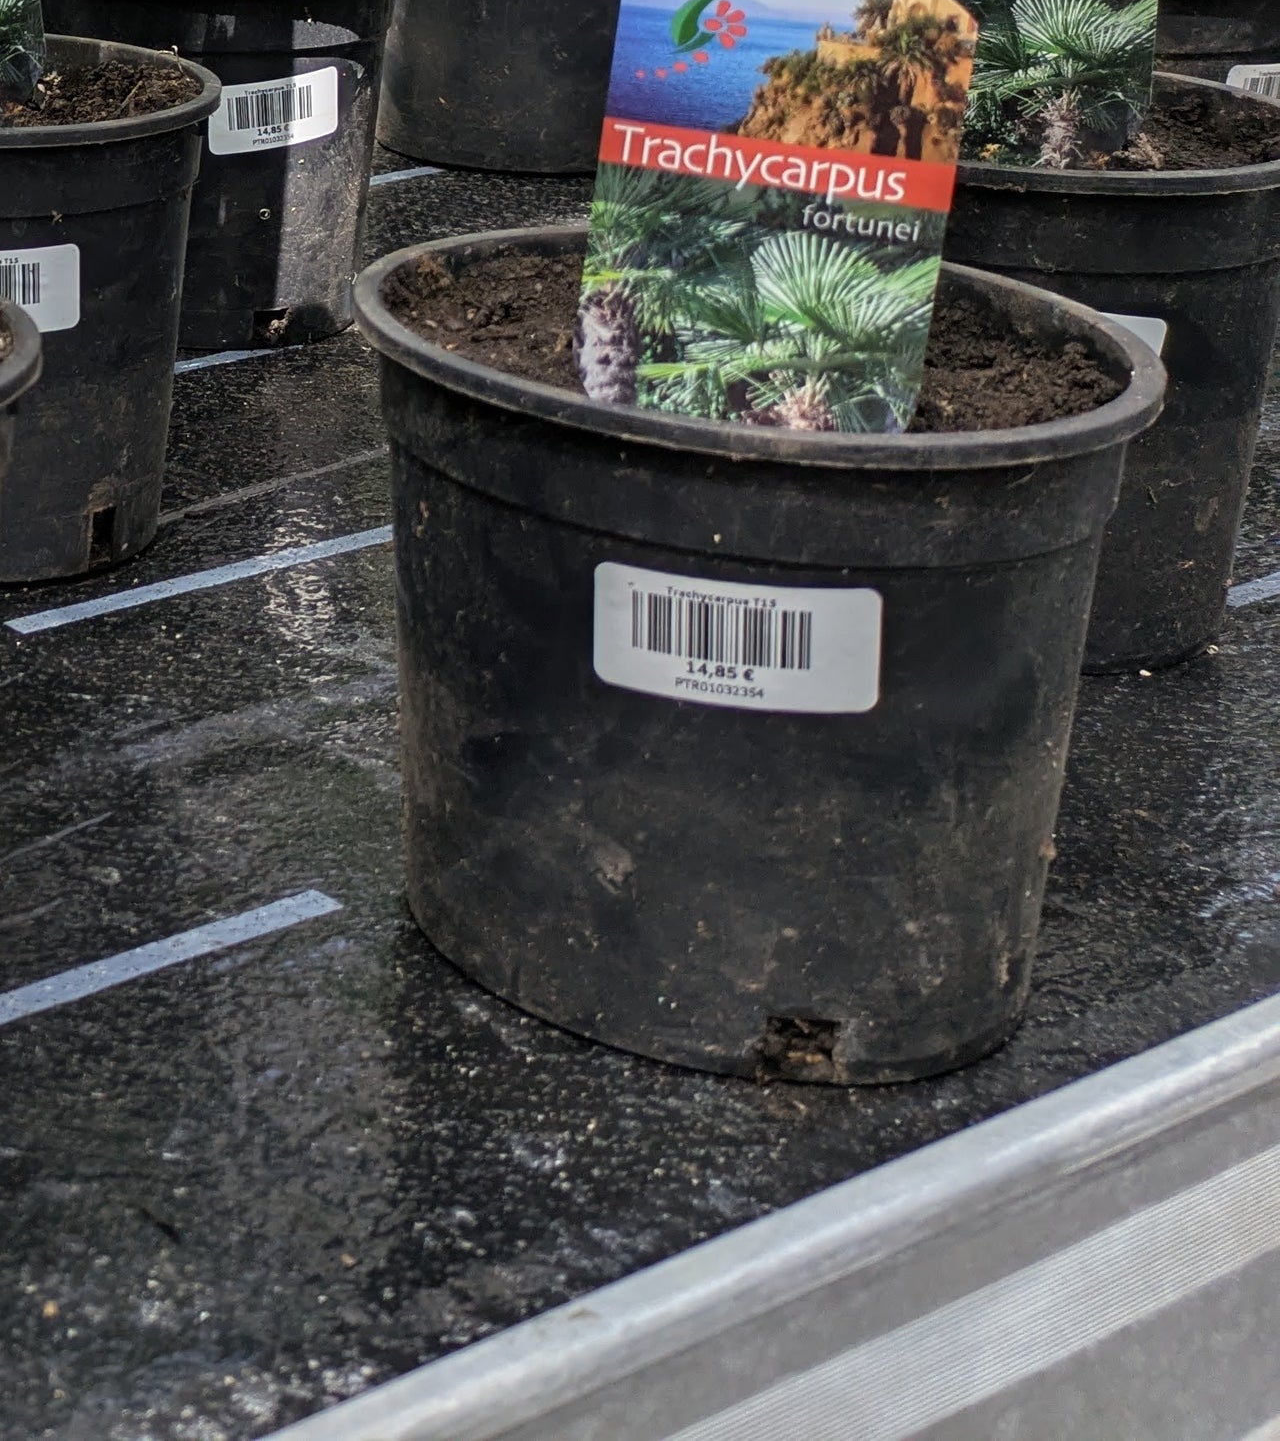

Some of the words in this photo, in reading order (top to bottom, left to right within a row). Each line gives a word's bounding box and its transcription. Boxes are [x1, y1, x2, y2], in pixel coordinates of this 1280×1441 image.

[257, 126, 282, 137] 14,85
[614, 124, 906, 204] Trachycarpus
[802, 205, 921, 242] fortunei
[666, 586, 750, 607] Trachycarpus
[685, 660, 738, 681] 14,85
[743, 668, 755, 681] €
[675, 678, 765, 699] PTR01032354
